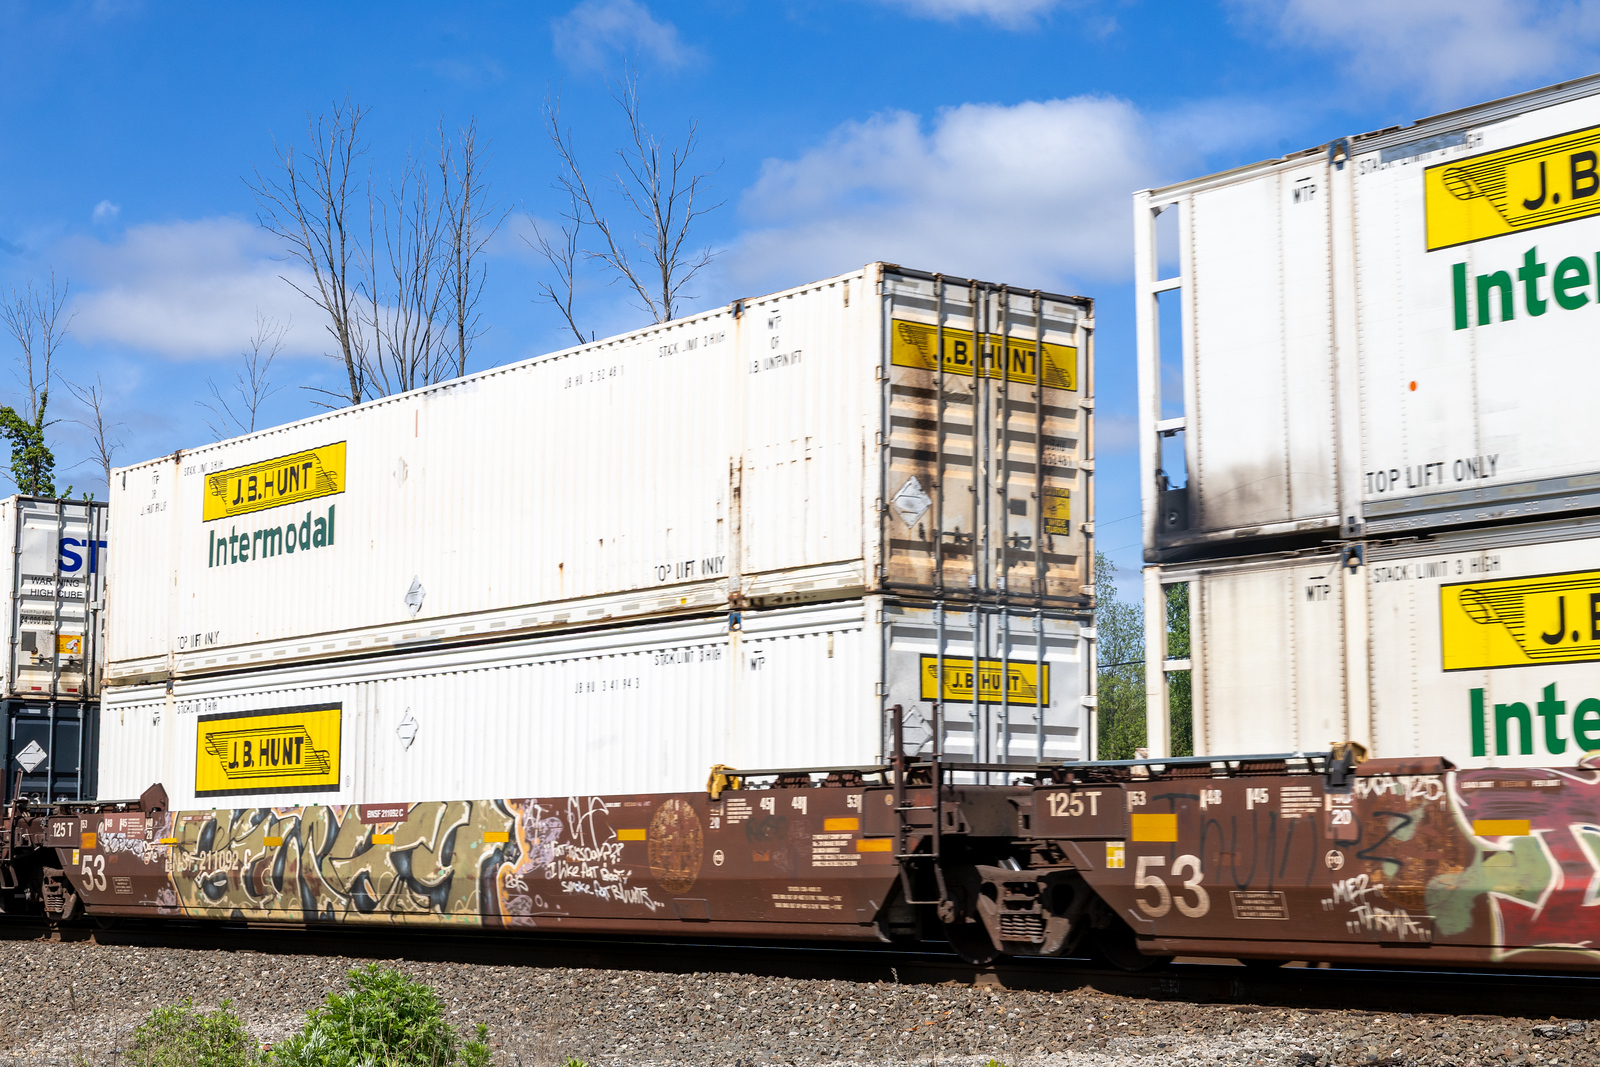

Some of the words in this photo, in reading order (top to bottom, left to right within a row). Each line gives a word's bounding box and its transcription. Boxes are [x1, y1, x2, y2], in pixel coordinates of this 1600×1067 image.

[1452, 244, 1600, 331] Inte
[264, 462, 313, 498] HUNT
[1366, 468, 1401, 494] TOP
[1406, 462, 1444, 489] LIFT
[1453, 453, 1499, 482] ONLY
[208, 504, 335, 568] Intermodal
[57, 537, 107, 574] ST
[676, 559, 695, 580] LIFT
[1373, 565, 1410, 583] STACK
[1416, 560, 1448, 579] LIMIT
[1455, 559, 1464, 575] 3
[1470, 555, 1501, 573] HIGH
[31, 588, 54, 598] HIGH
[57, 590, 83, 599] CUBE
[1304, 583, 1332, 602] MTP
[259, 736, 304, 767] HUNT
[399, 808, 404, 817] C
[1046, 792, 1085, 817] 125
[1085, 791, 1102, 816] T
[1131, 790, 1147, 806] 53
[1206, 789, 1222, 805] 48
[1253, 788, 1269, 803] 45
[53, 822, 66, 838] 125
[67, 822, 73, 838] T
[709, 817, 720, 829] 20
[1331, 809, 1353, 825] 20
[81, 854, 107, 892] 53
[199, 850, 239, 871] 211092
[1134, 854, 1211, 918] 53
